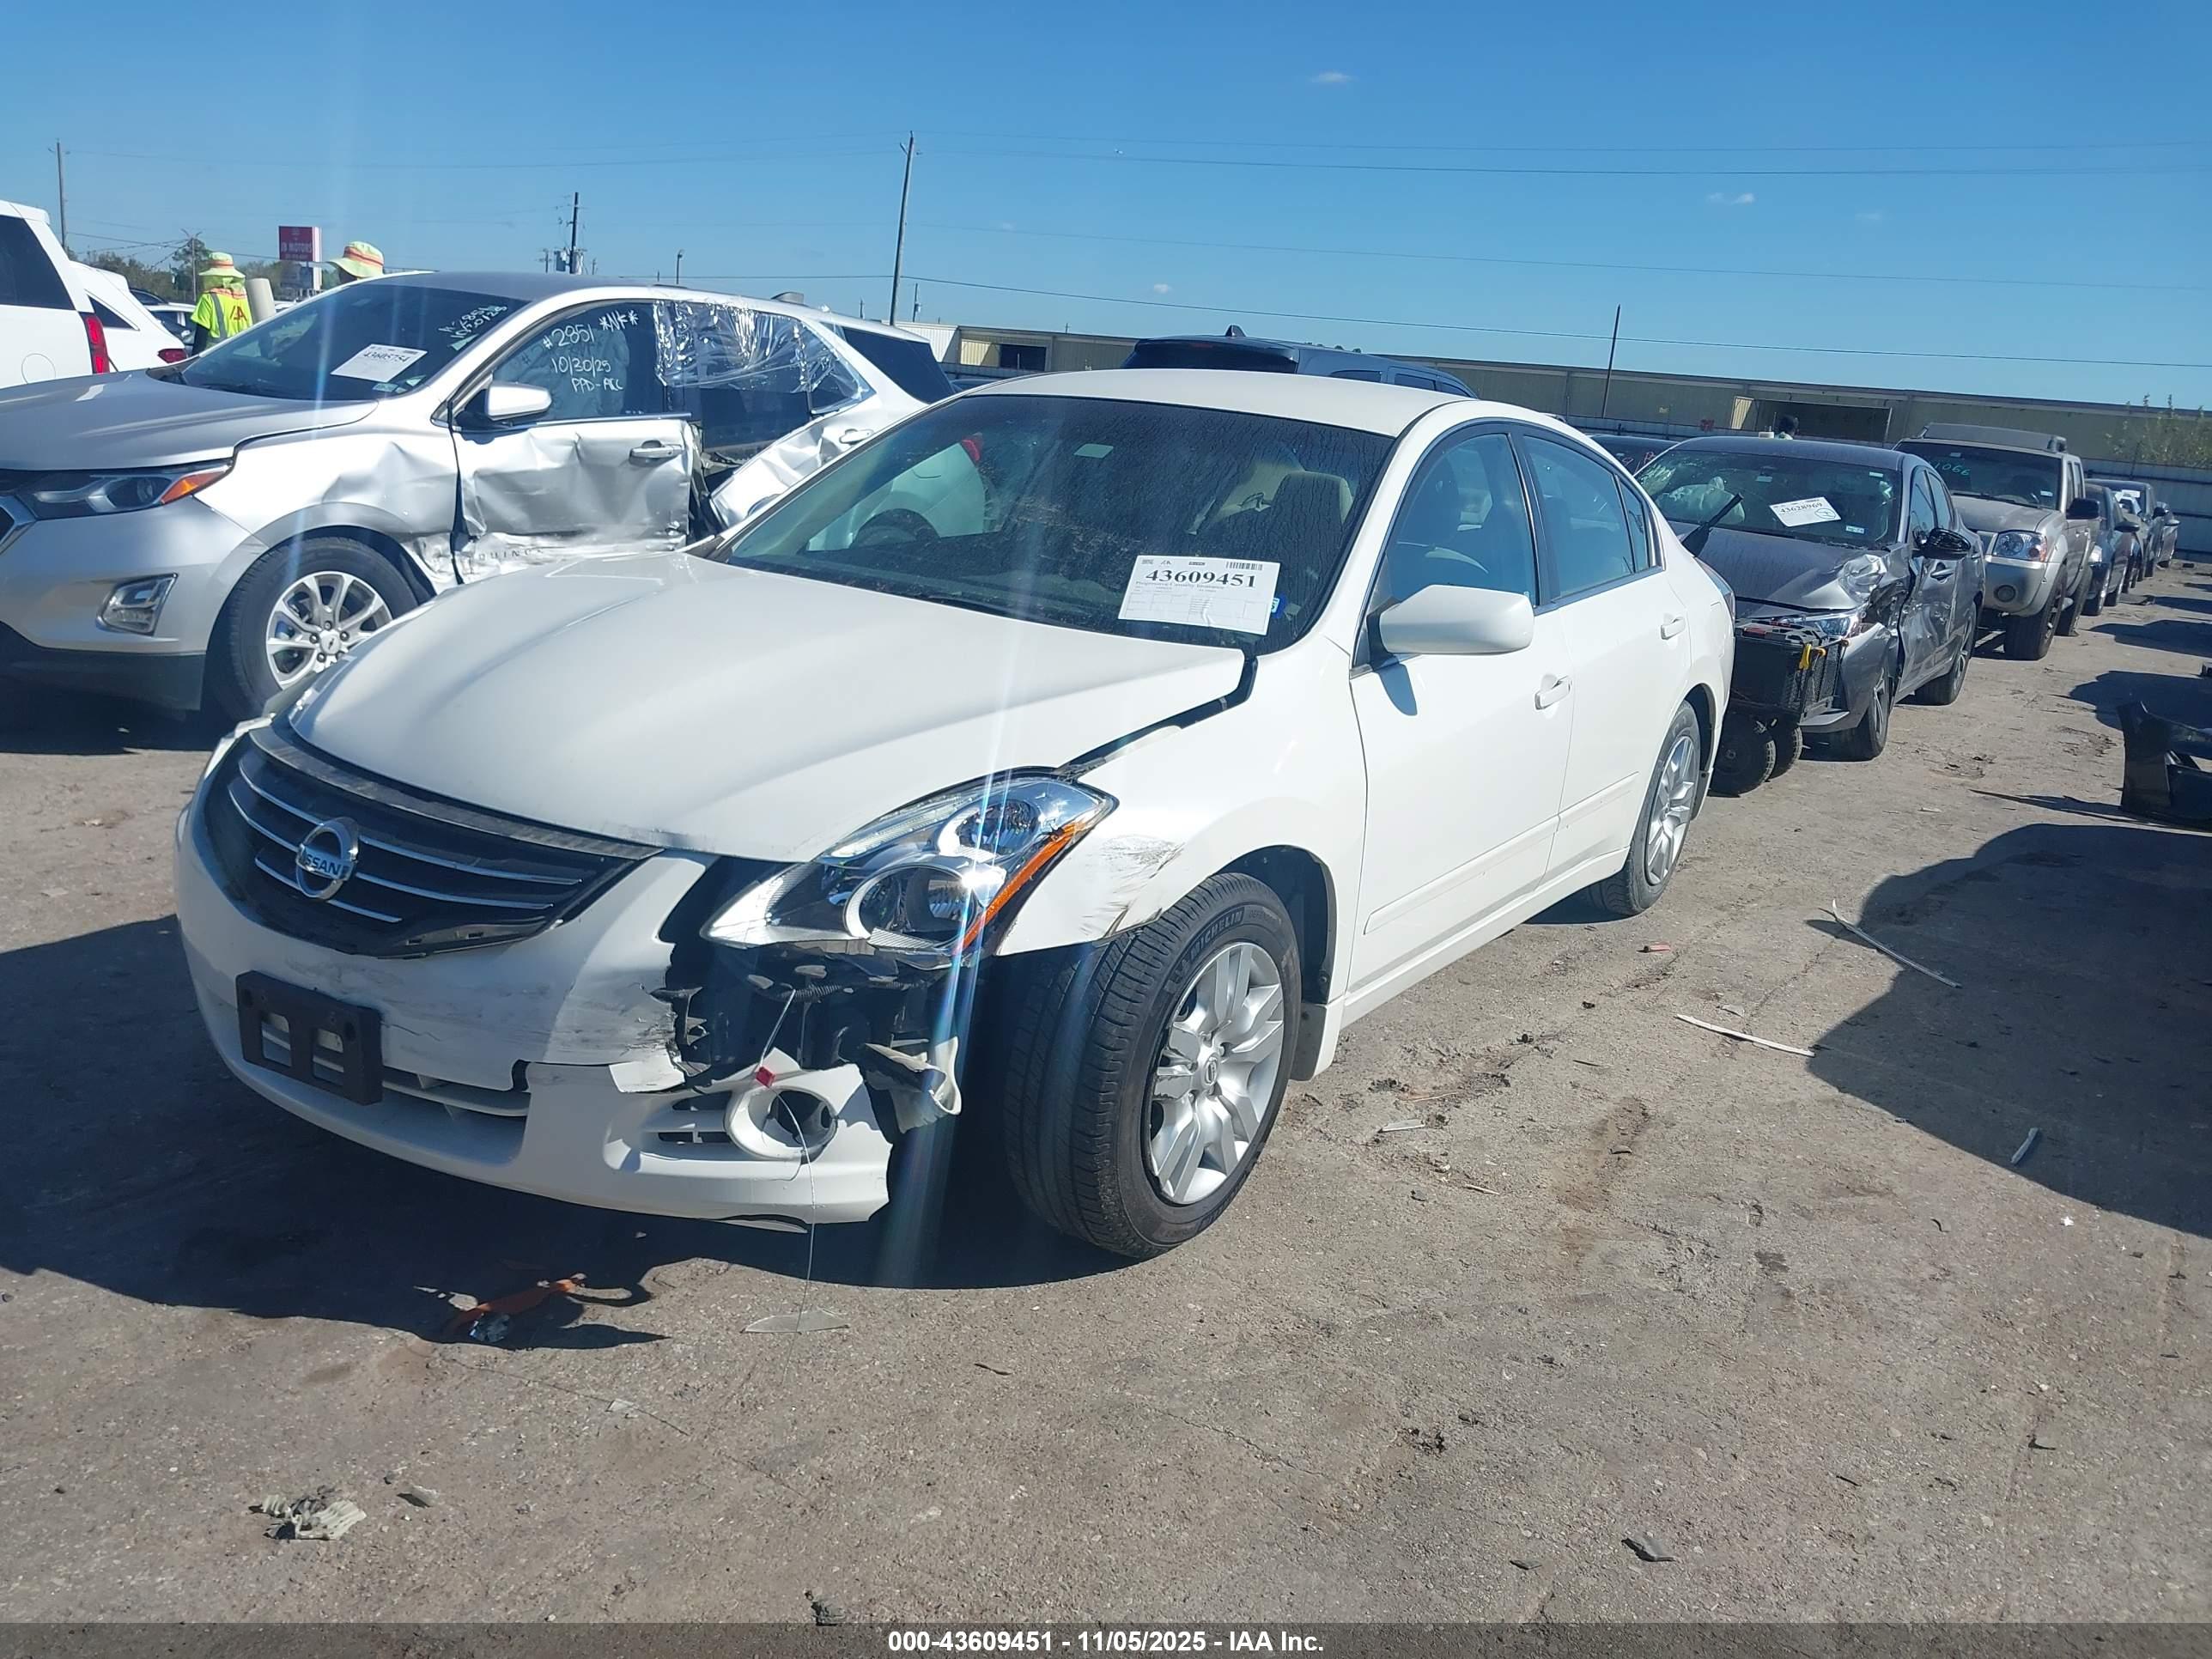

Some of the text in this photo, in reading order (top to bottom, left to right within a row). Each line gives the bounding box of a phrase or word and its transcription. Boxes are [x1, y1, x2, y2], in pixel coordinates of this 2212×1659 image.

[551, 356, 611, 378] 10/30/25
[1145, 569, 1256, 587] 43609451
[1189, 910, 1243, 961] MICHELIN
